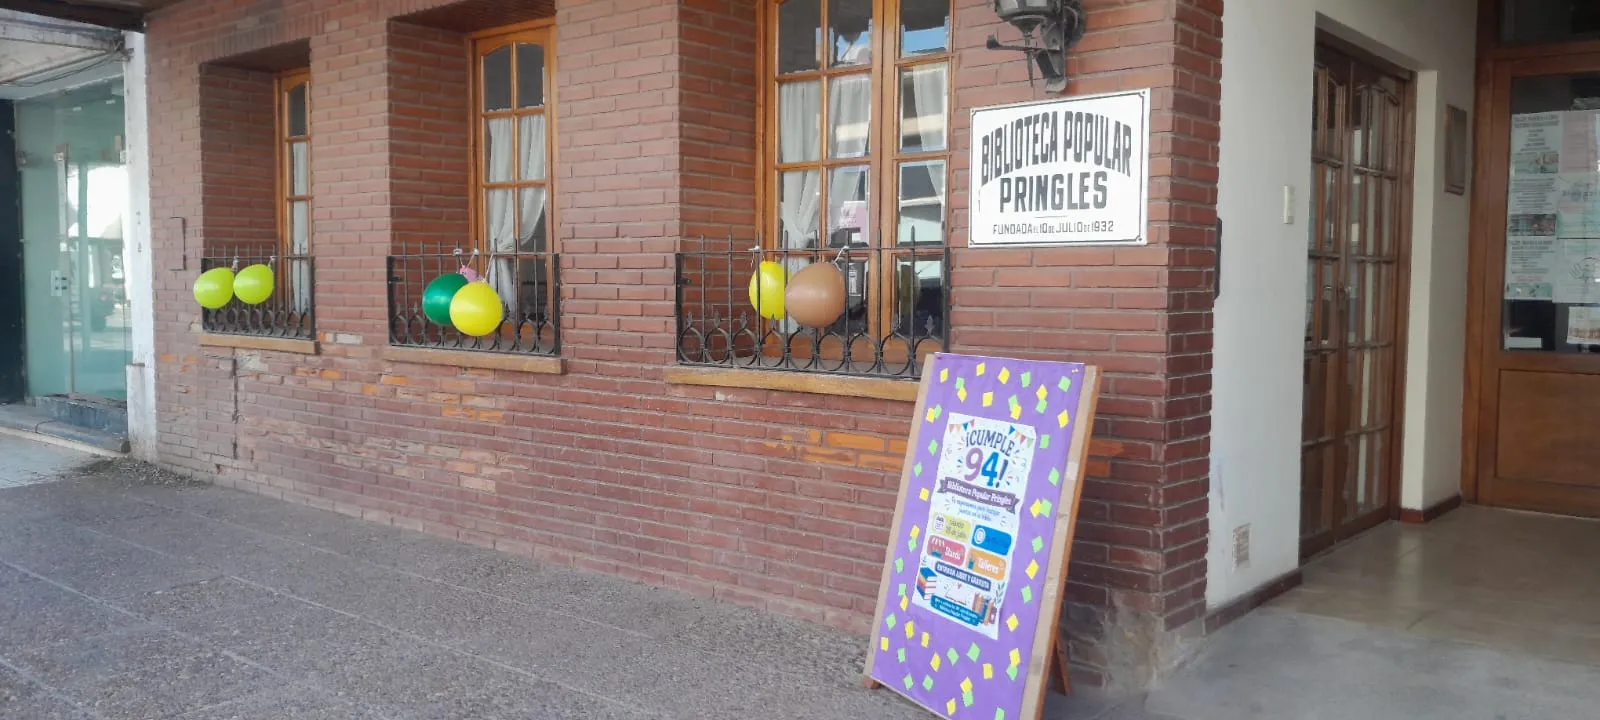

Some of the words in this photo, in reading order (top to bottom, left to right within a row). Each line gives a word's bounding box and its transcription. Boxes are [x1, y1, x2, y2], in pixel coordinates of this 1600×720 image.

[981, 111, 1058, 187] BIBLIOTECA
[1064, 111, 1132, 177] POPULAR
[1000, 171, 1108, 213] PRINGLES
[993, 223, 1032, 235] FUNDADA
[1040, 222, 1048, 233] 10
[1048, 225, 1055, 233] DE
[1056, 221, 1083, 233] JULIO
[1091, 220, 1114, 232] 1932
[966, 429, 1015, 457] ¡CUMPLE
[964, 447, 1009, 488] 94!
[971, 488, 991, 500] Popular
[990, 492, 1012, 506] Pringles
